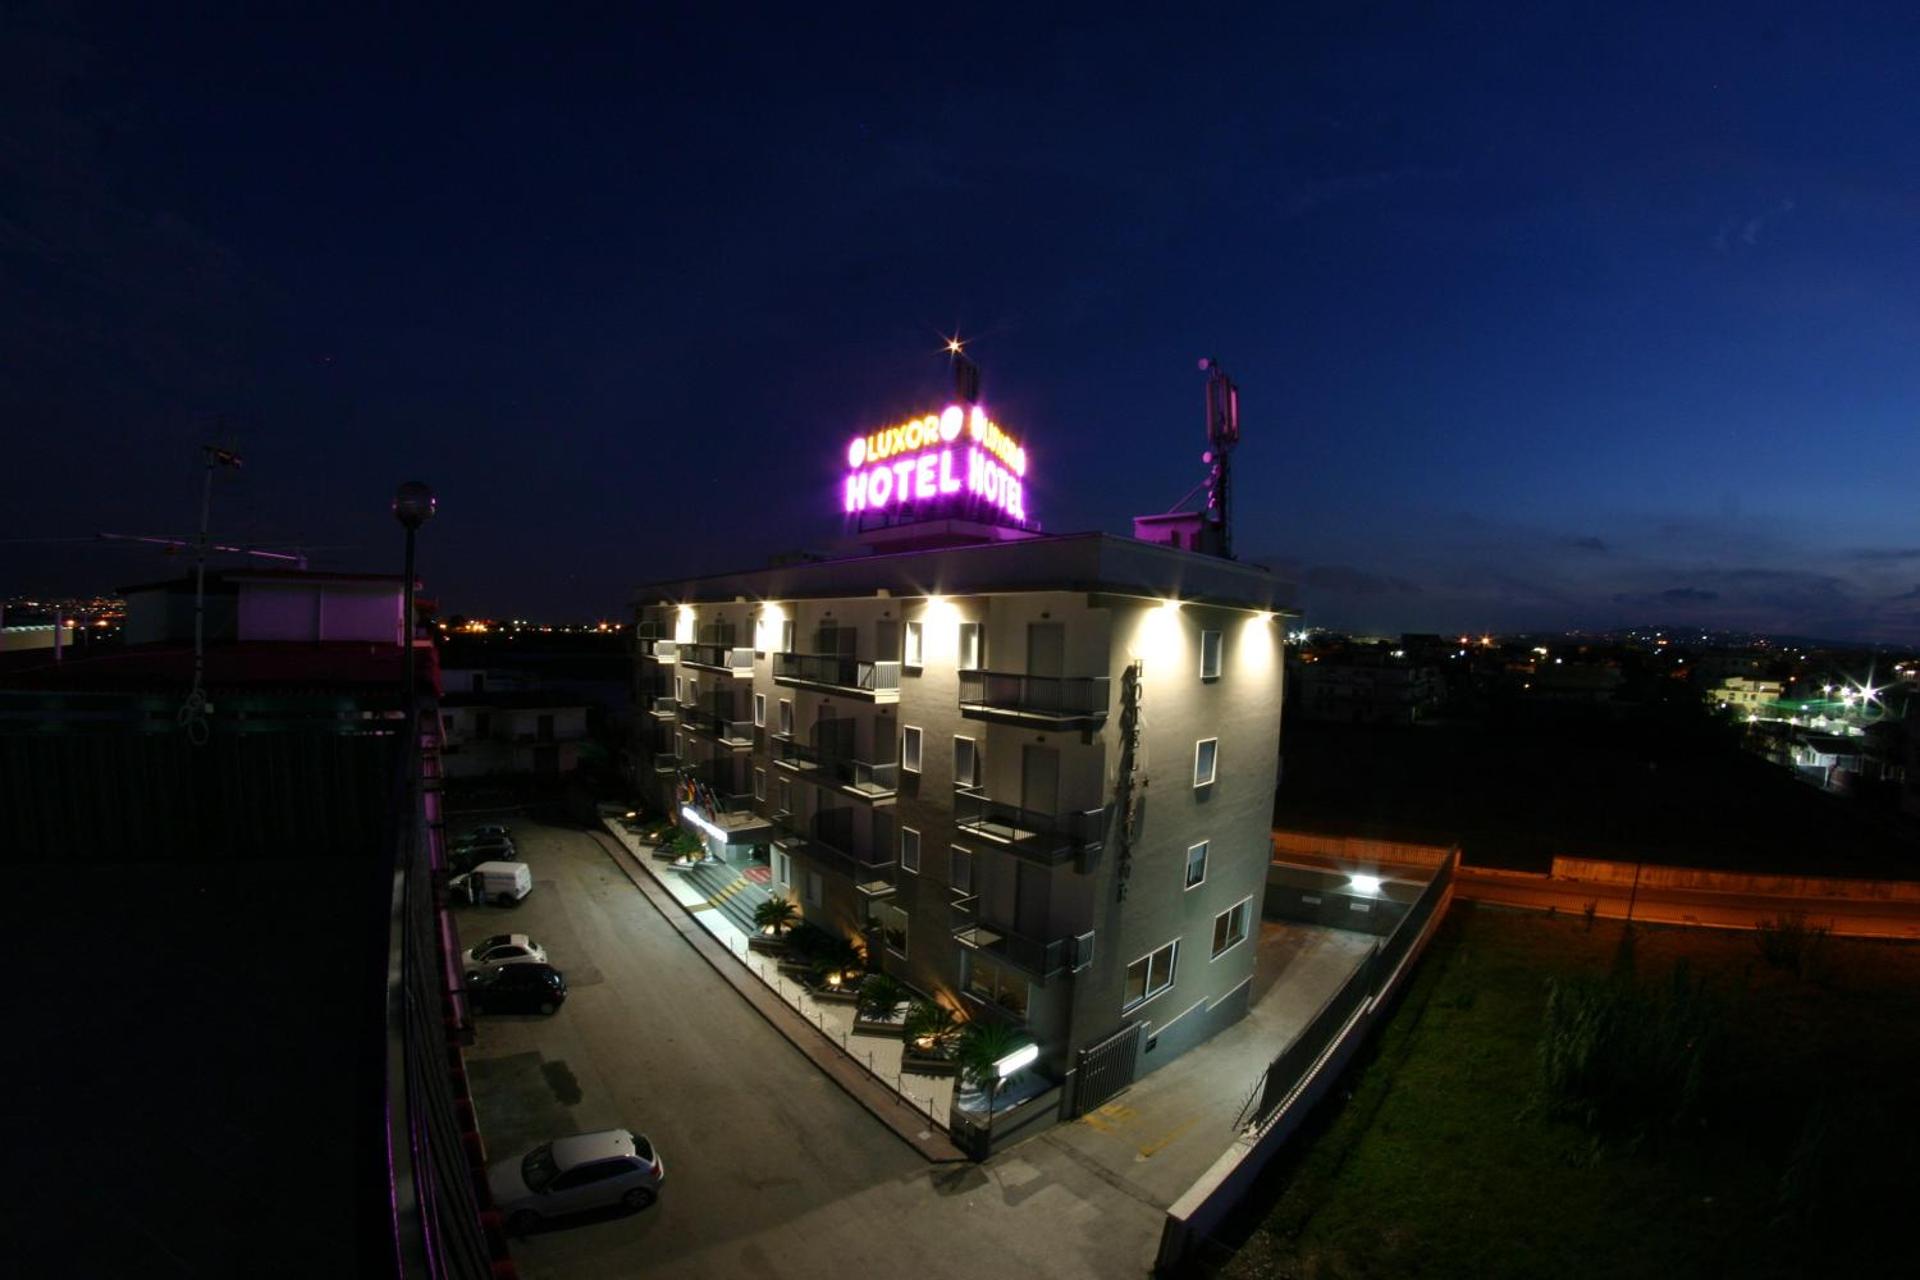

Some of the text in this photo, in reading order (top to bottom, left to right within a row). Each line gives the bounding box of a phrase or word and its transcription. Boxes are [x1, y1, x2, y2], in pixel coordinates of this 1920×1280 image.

[866, 415, 939, 462] LUXOR
[845, 450, 961, 512] HOTEL
[969, 447, 1025, 520] HOTEL
